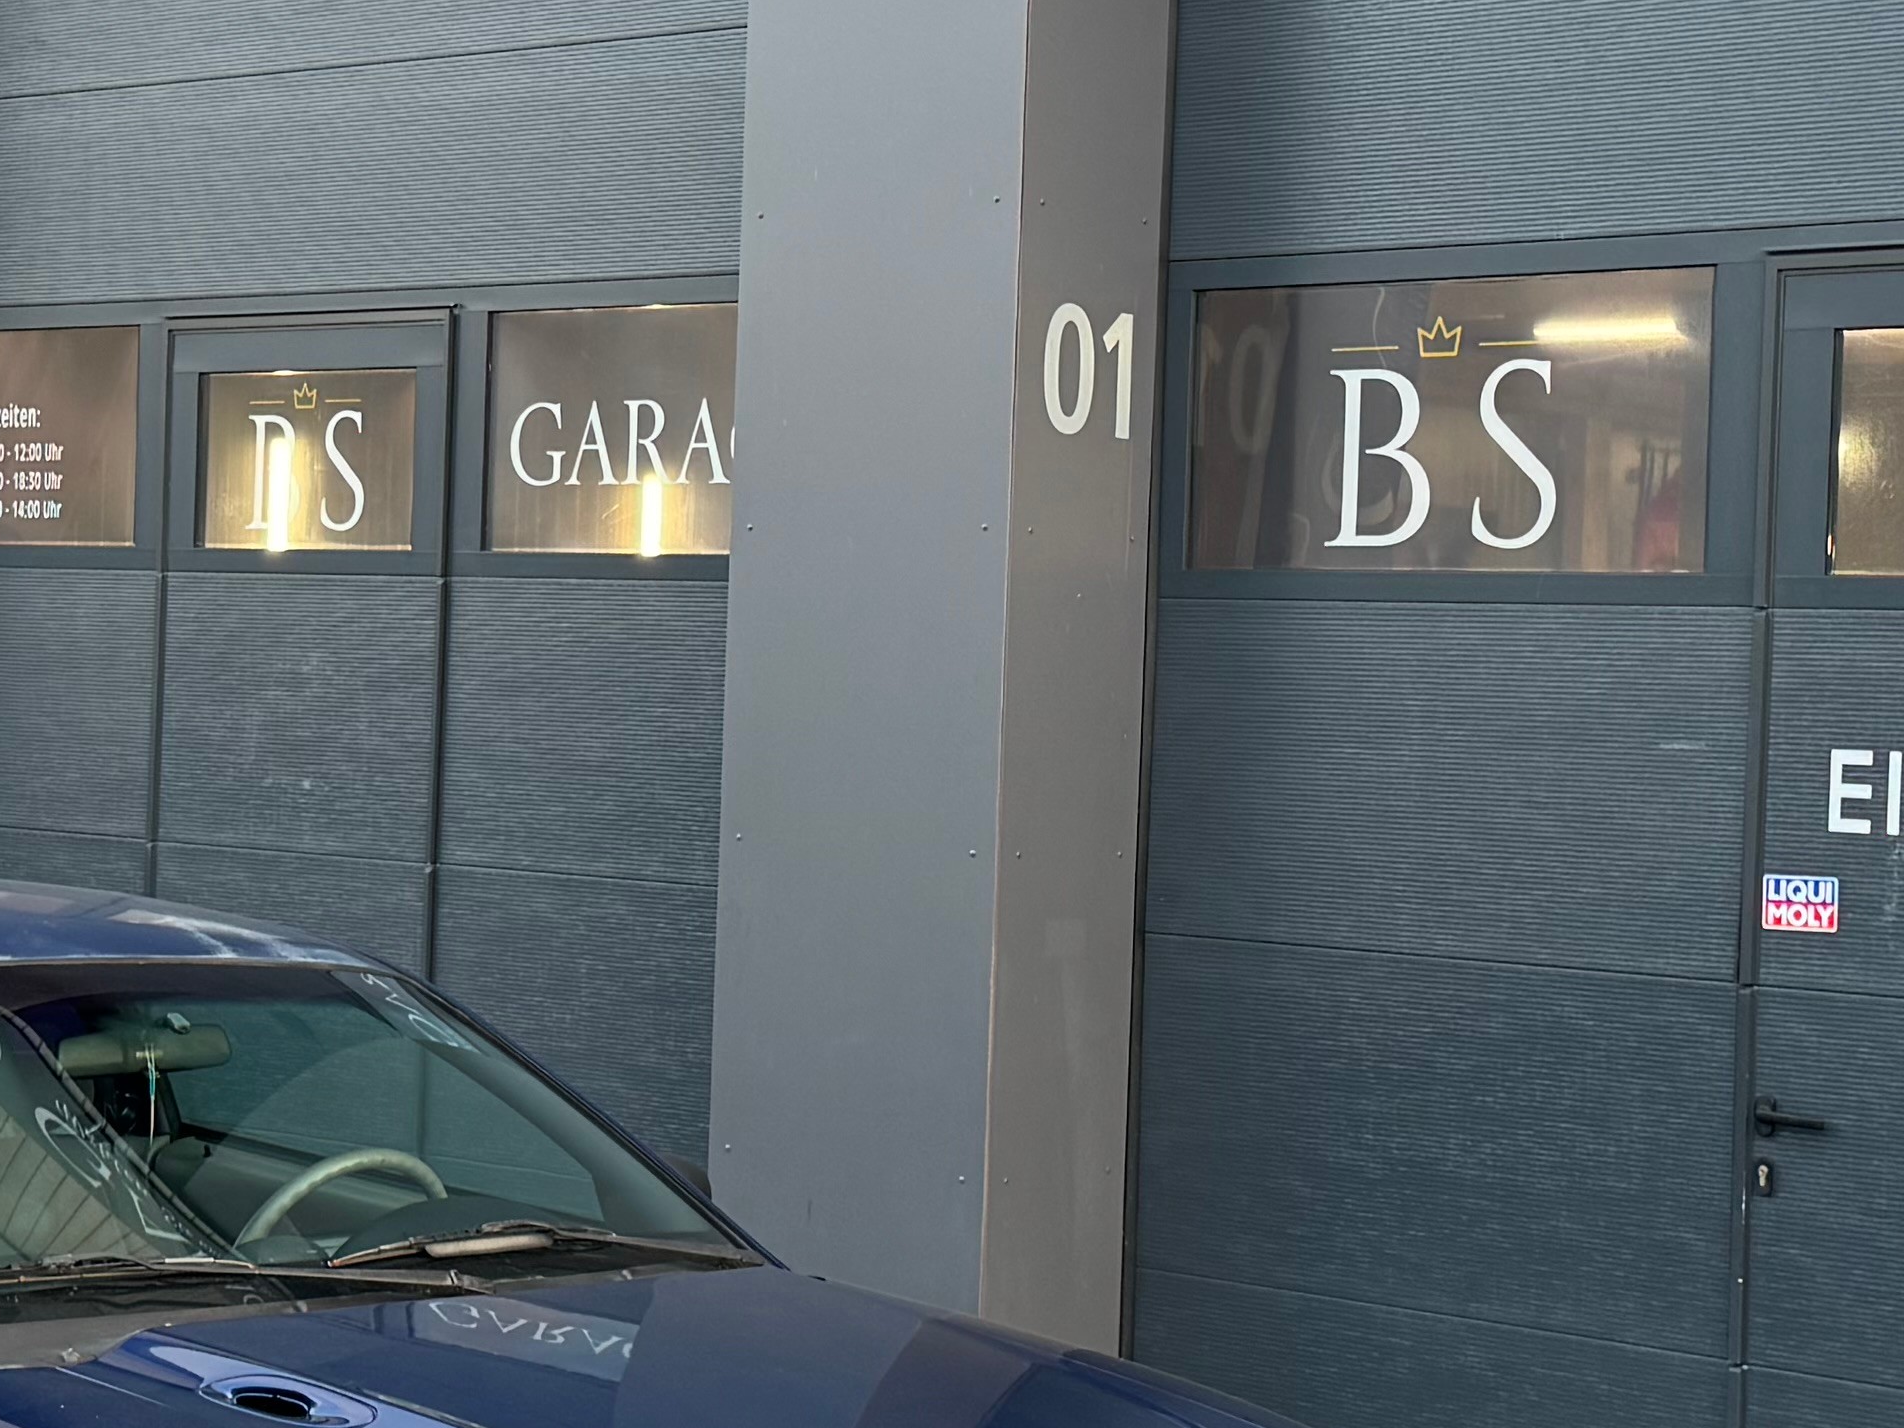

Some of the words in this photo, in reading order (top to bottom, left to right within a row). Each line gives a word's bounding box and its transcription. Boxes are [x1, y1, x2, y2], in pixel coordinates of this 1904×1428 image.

[1044, 302, 1134, 440] 01
[14, 443, 42, 462] 12:00
[45, 442, 64, 462] Uhr
[511, 397, 736, 487] GARA
[13, 471, 41, 490] 18:30
[44, 471, 63, 490] Uhr
[12, 500, 40, 519] 14:00
[43, 499, 62, 519] Uhr
[1768, 879, 1833, 903] LIQUI
[1767, 902, 1834, 928] MOLY
